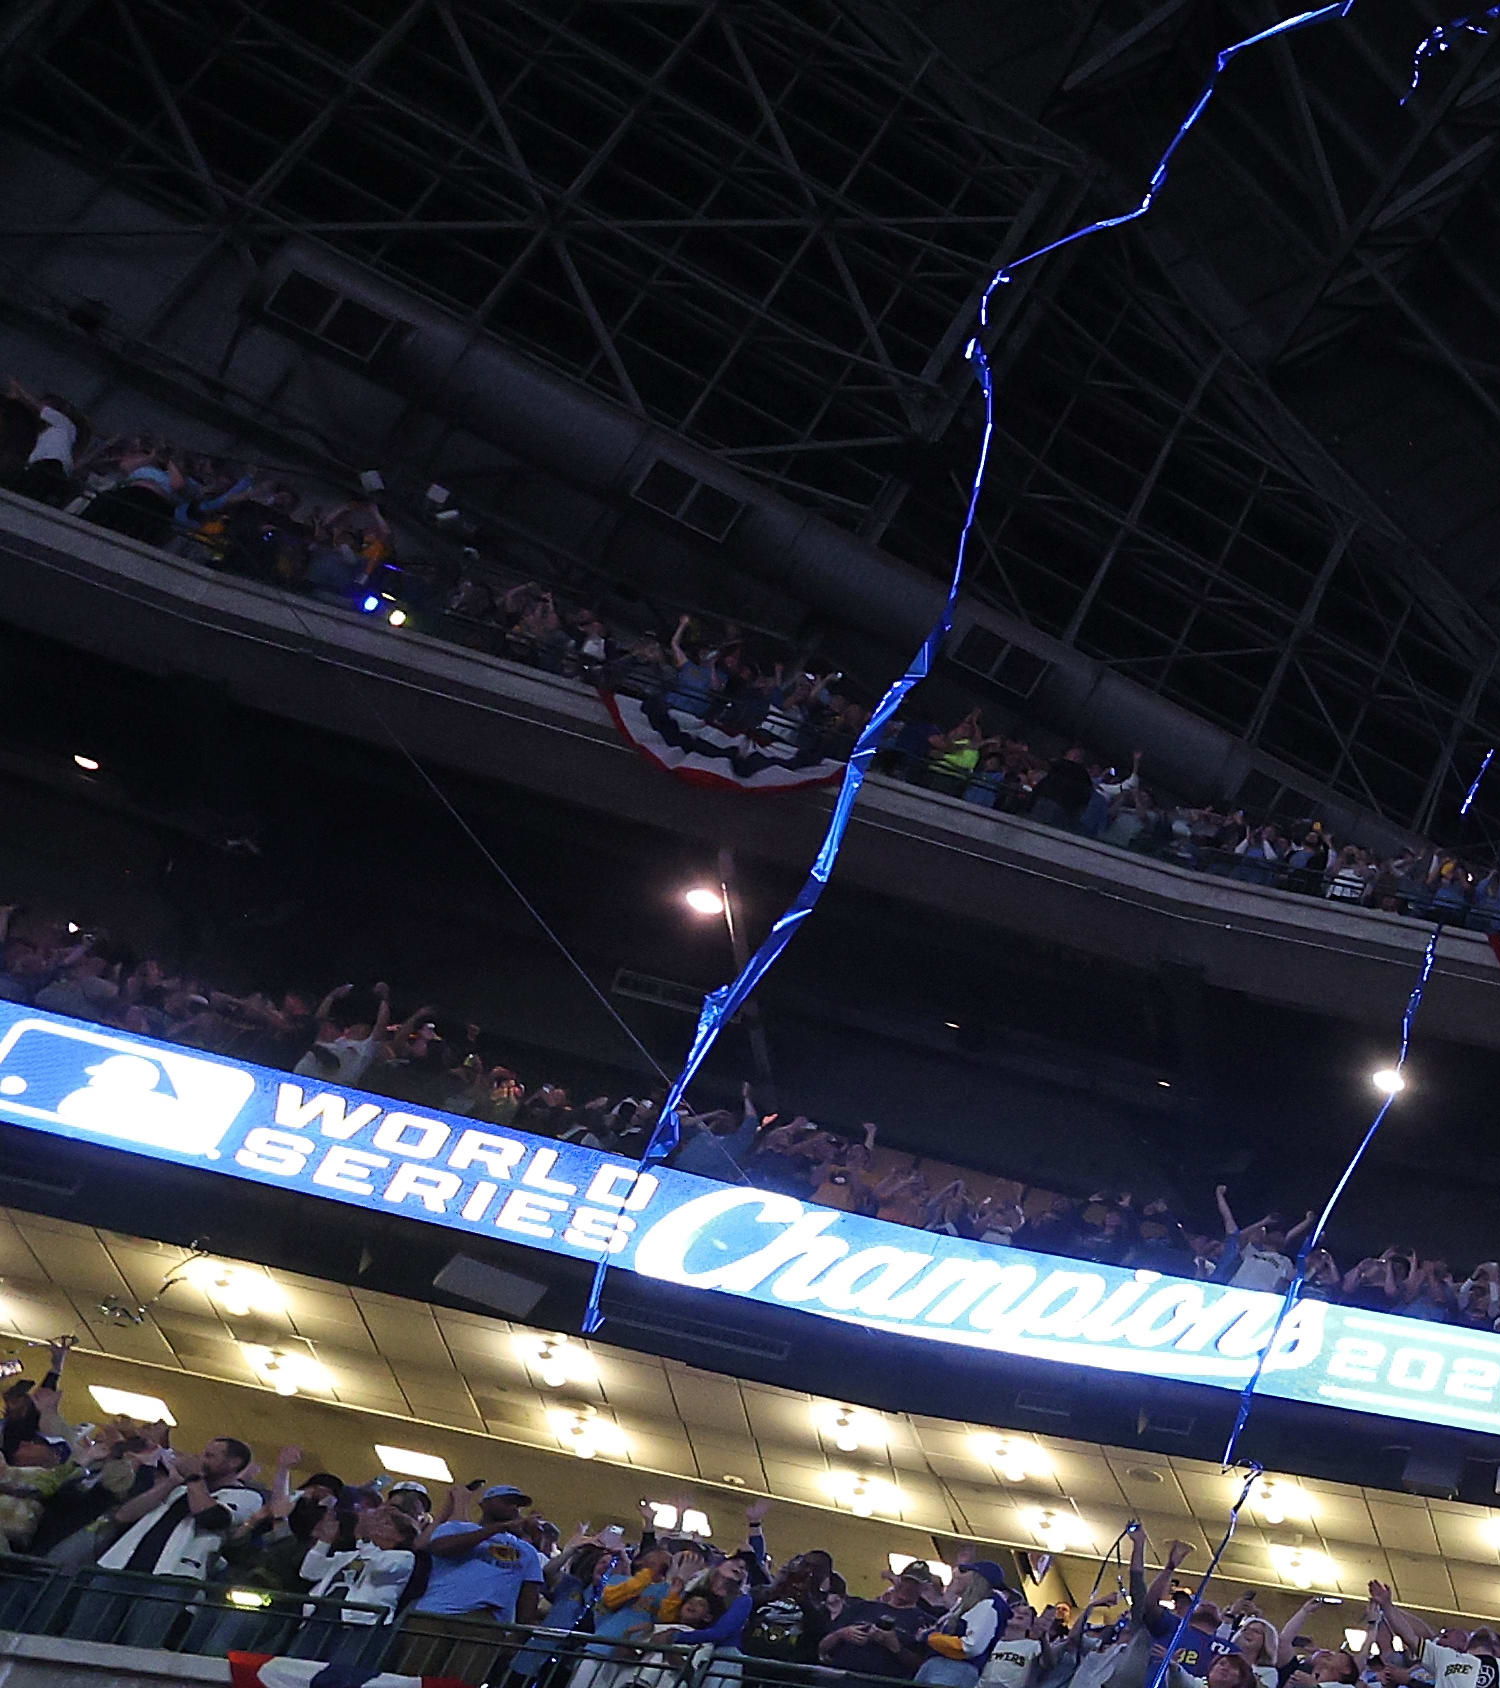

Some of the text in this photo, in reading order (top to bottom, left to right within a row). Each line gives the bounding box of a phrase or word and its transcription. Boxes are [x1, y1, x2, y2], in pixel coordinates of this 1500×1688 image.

[234, 1126, 639, 1254] SERIES
[274, 1082, 661, 1212] WORLD
[635, 1185, 1327, 1378] Champions
